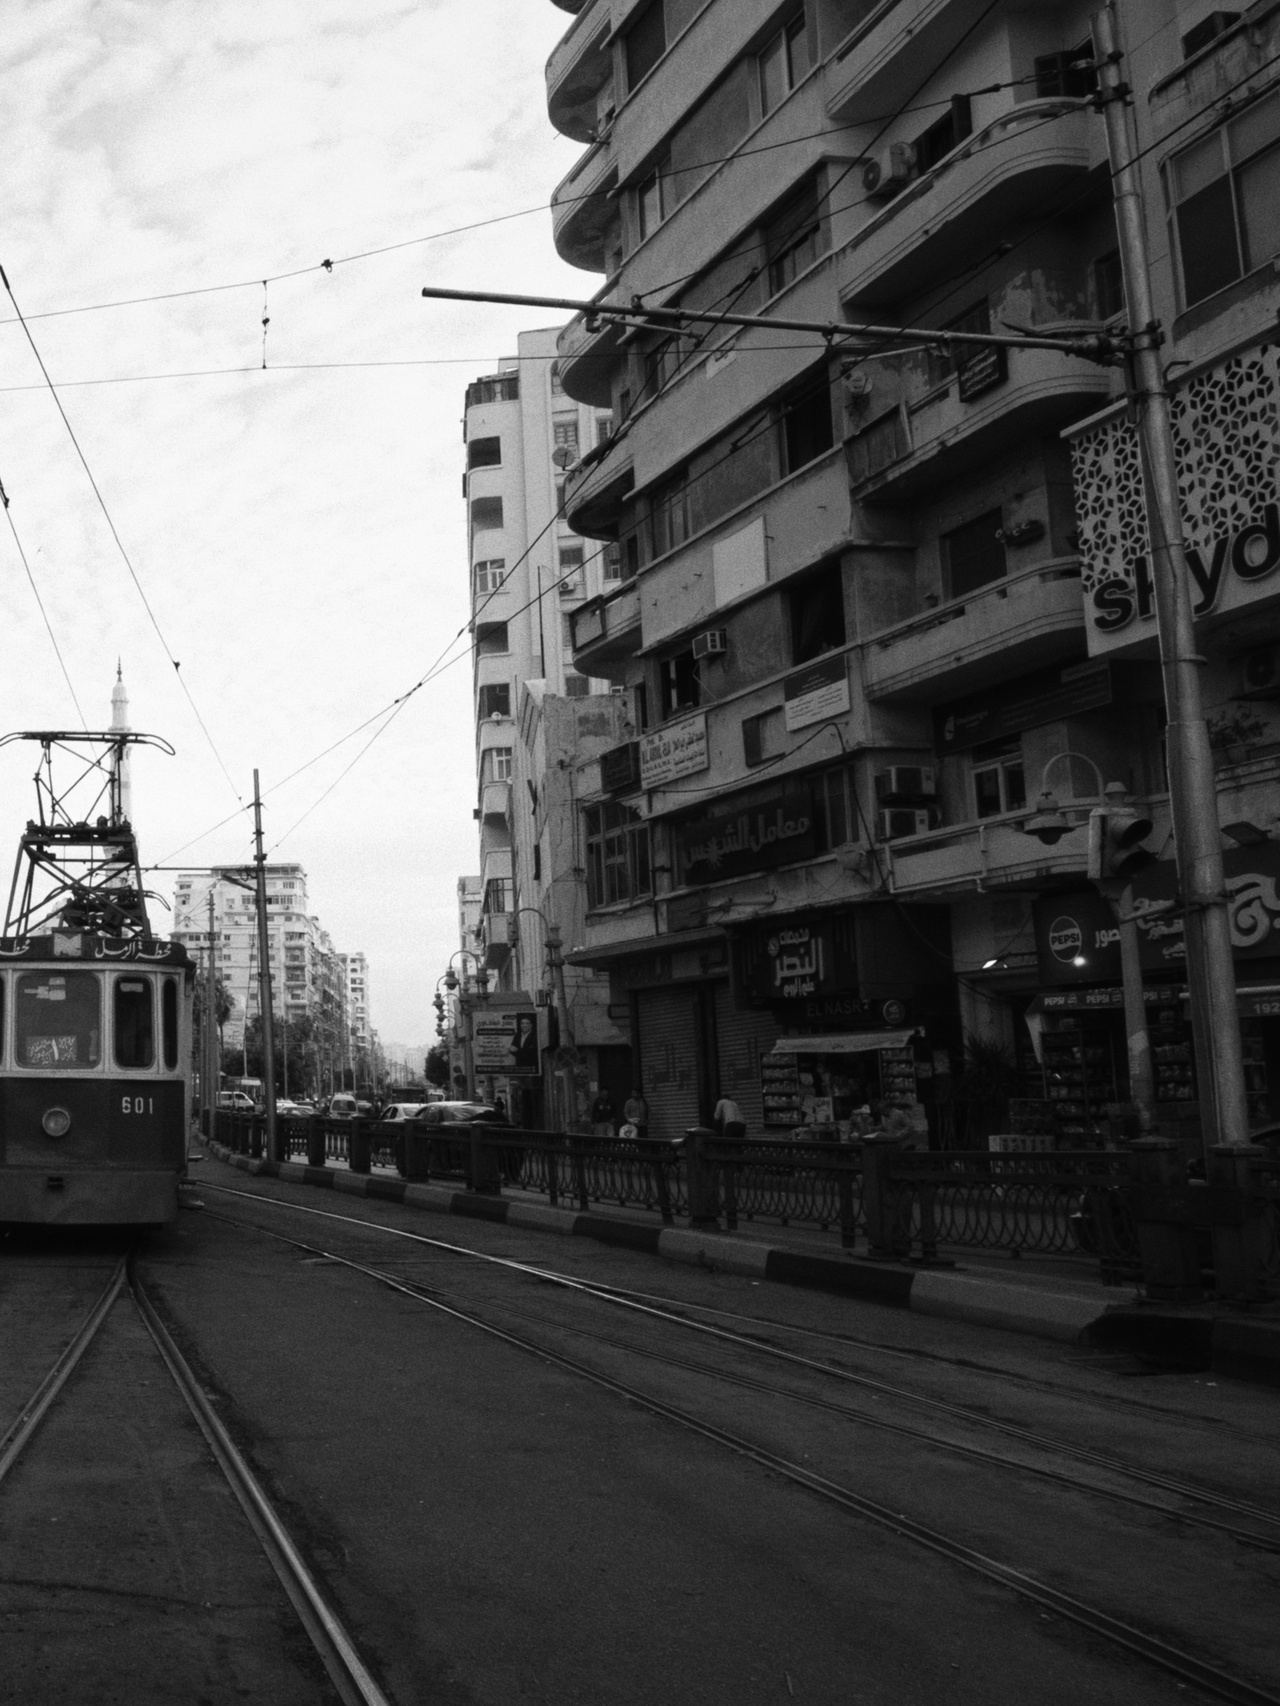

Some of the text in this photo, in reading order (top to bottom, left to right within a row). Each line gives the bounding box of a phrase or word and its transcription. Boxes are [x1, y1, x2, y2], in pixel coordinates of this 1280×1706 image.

[750, 808, 811, 853] معامل
[1051, 932, 1080, 947] PEPSI
[94, 937, 172, 960] محطة الرمل
[1044, 996, 1065, 1006] PEPSI
[1086, 994, 1109, 1004] PEPSI
[1143, 991, 1158, 1000] PSI
[807, 1000, 863, 1017] EL NASR
[121, 1096, 154, 1115] 601
